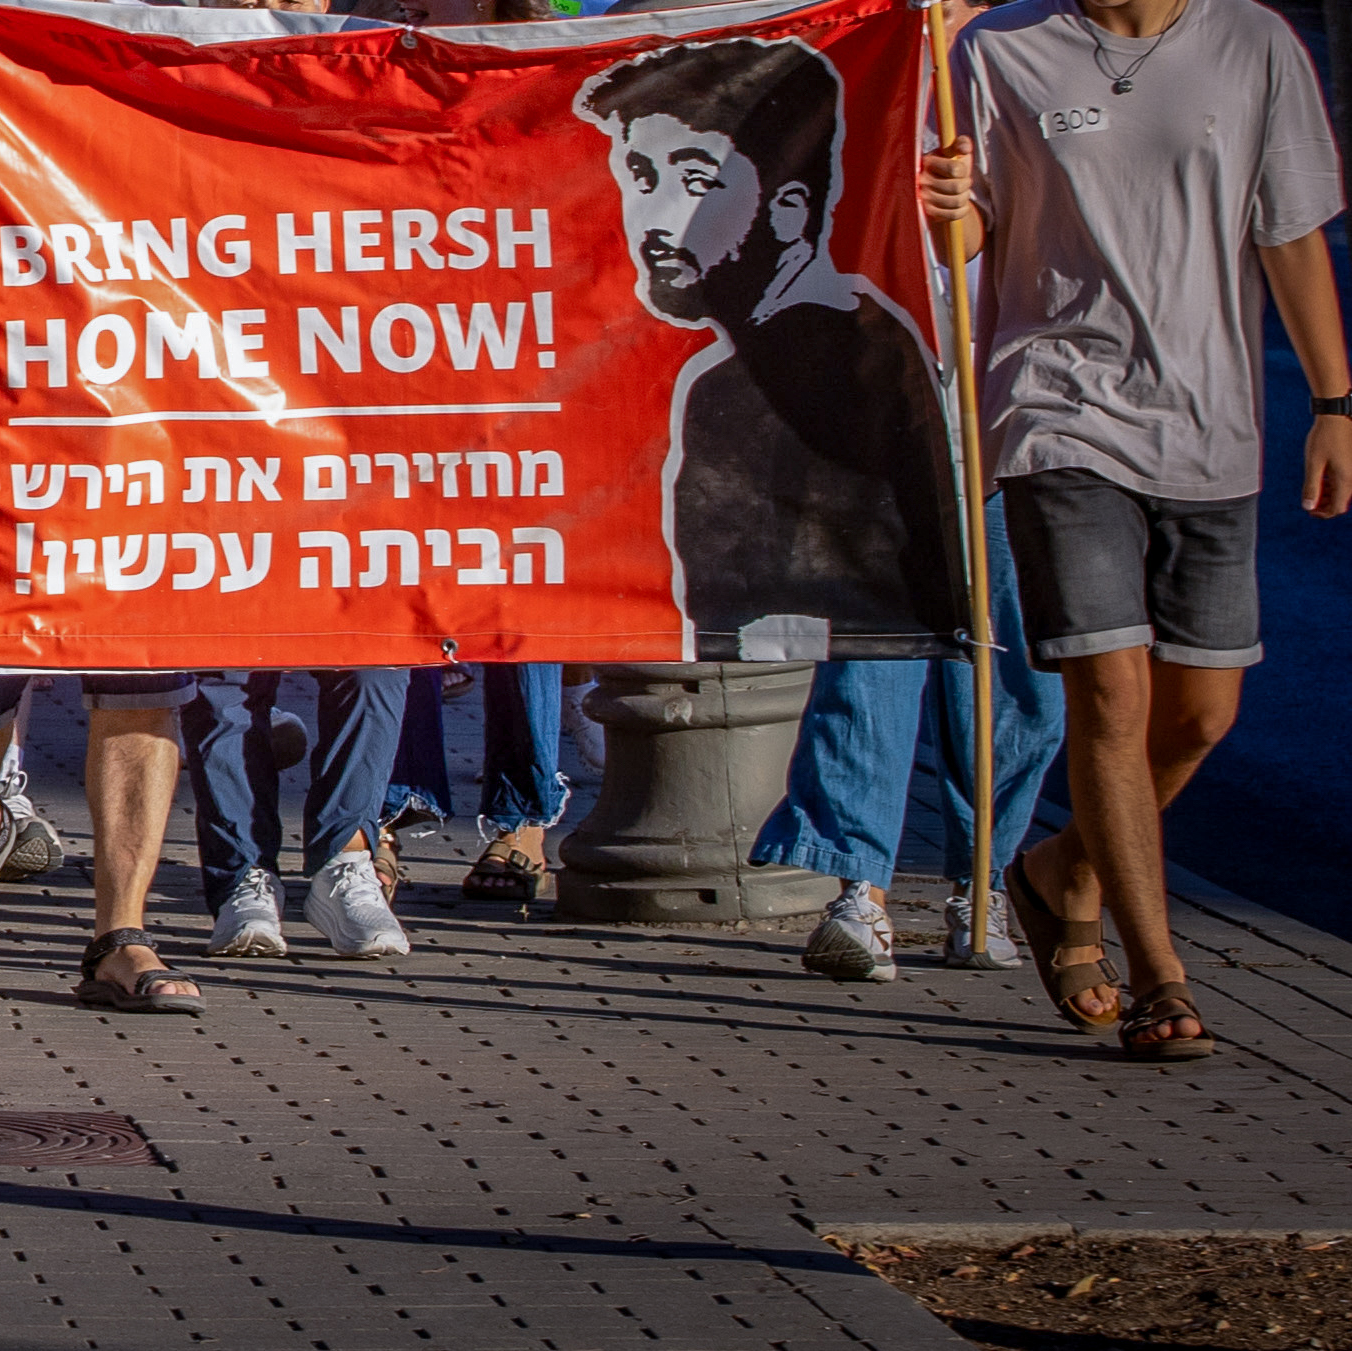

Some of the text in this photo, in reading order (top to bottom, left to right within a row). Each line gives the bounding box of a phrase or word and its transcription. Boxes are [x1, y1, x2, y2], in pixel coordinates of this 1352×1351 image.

[1053, 107, 1101, 133] 300
[0, 208, 553, 286] BRING HERSH
[5, 290, 556, 389] HOME NOW!
[11, 449, 565, 511] מחזירים את הירש
[16, 522, 565, 597] הביתה עכשיו!
